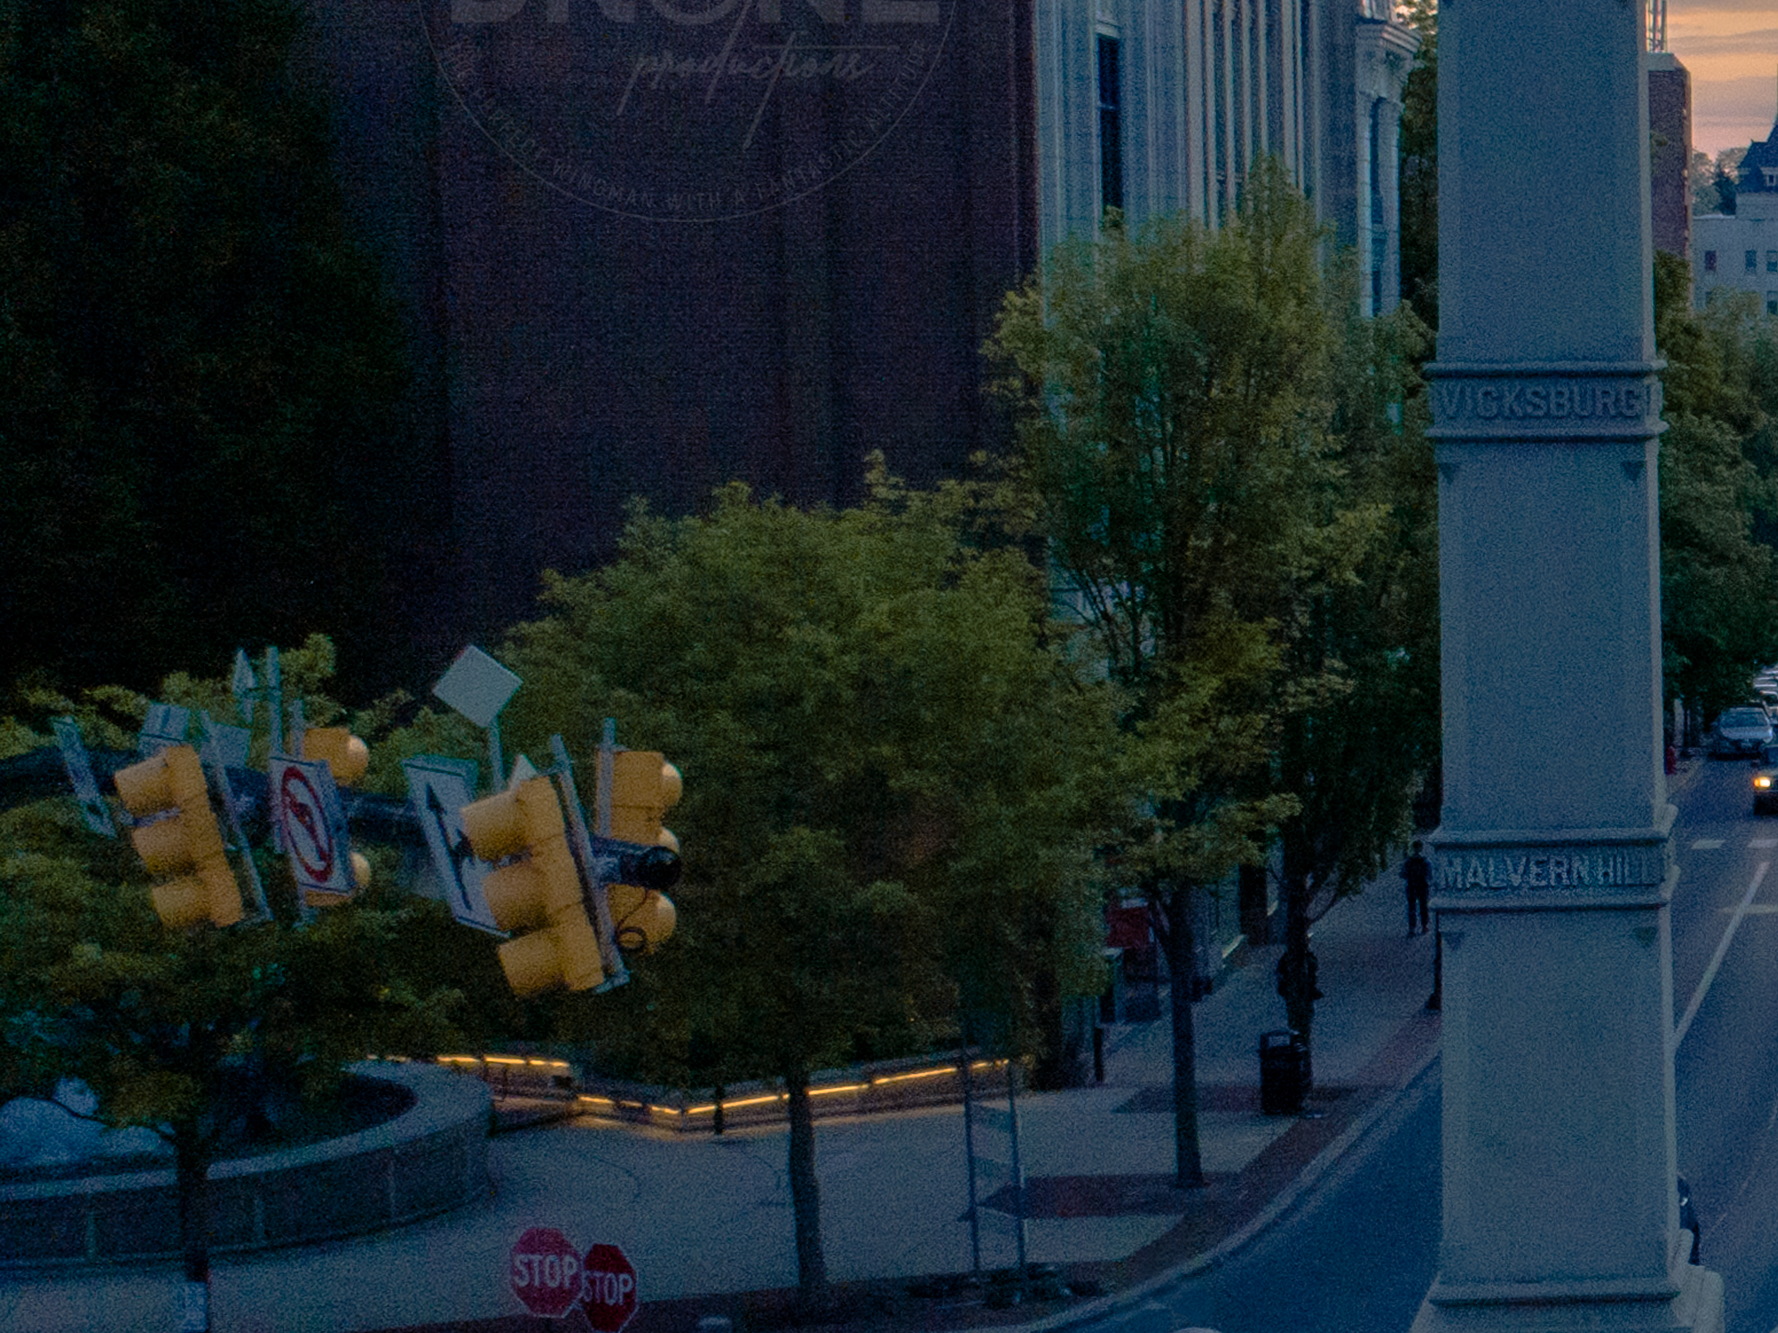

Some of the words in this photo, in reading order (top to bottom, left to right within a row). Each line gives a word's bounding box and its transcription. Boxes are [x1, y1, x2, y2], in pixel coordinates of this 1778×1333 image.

[1437, 381, 1644, 418] VICKSBURG
[1438, 855, 1590, 889] MALVERN
[1597, 853, 1660, 886] HILL
[513, 1252, 577, 1289] STOP
[581, 1270, 634, 1307] STOP
